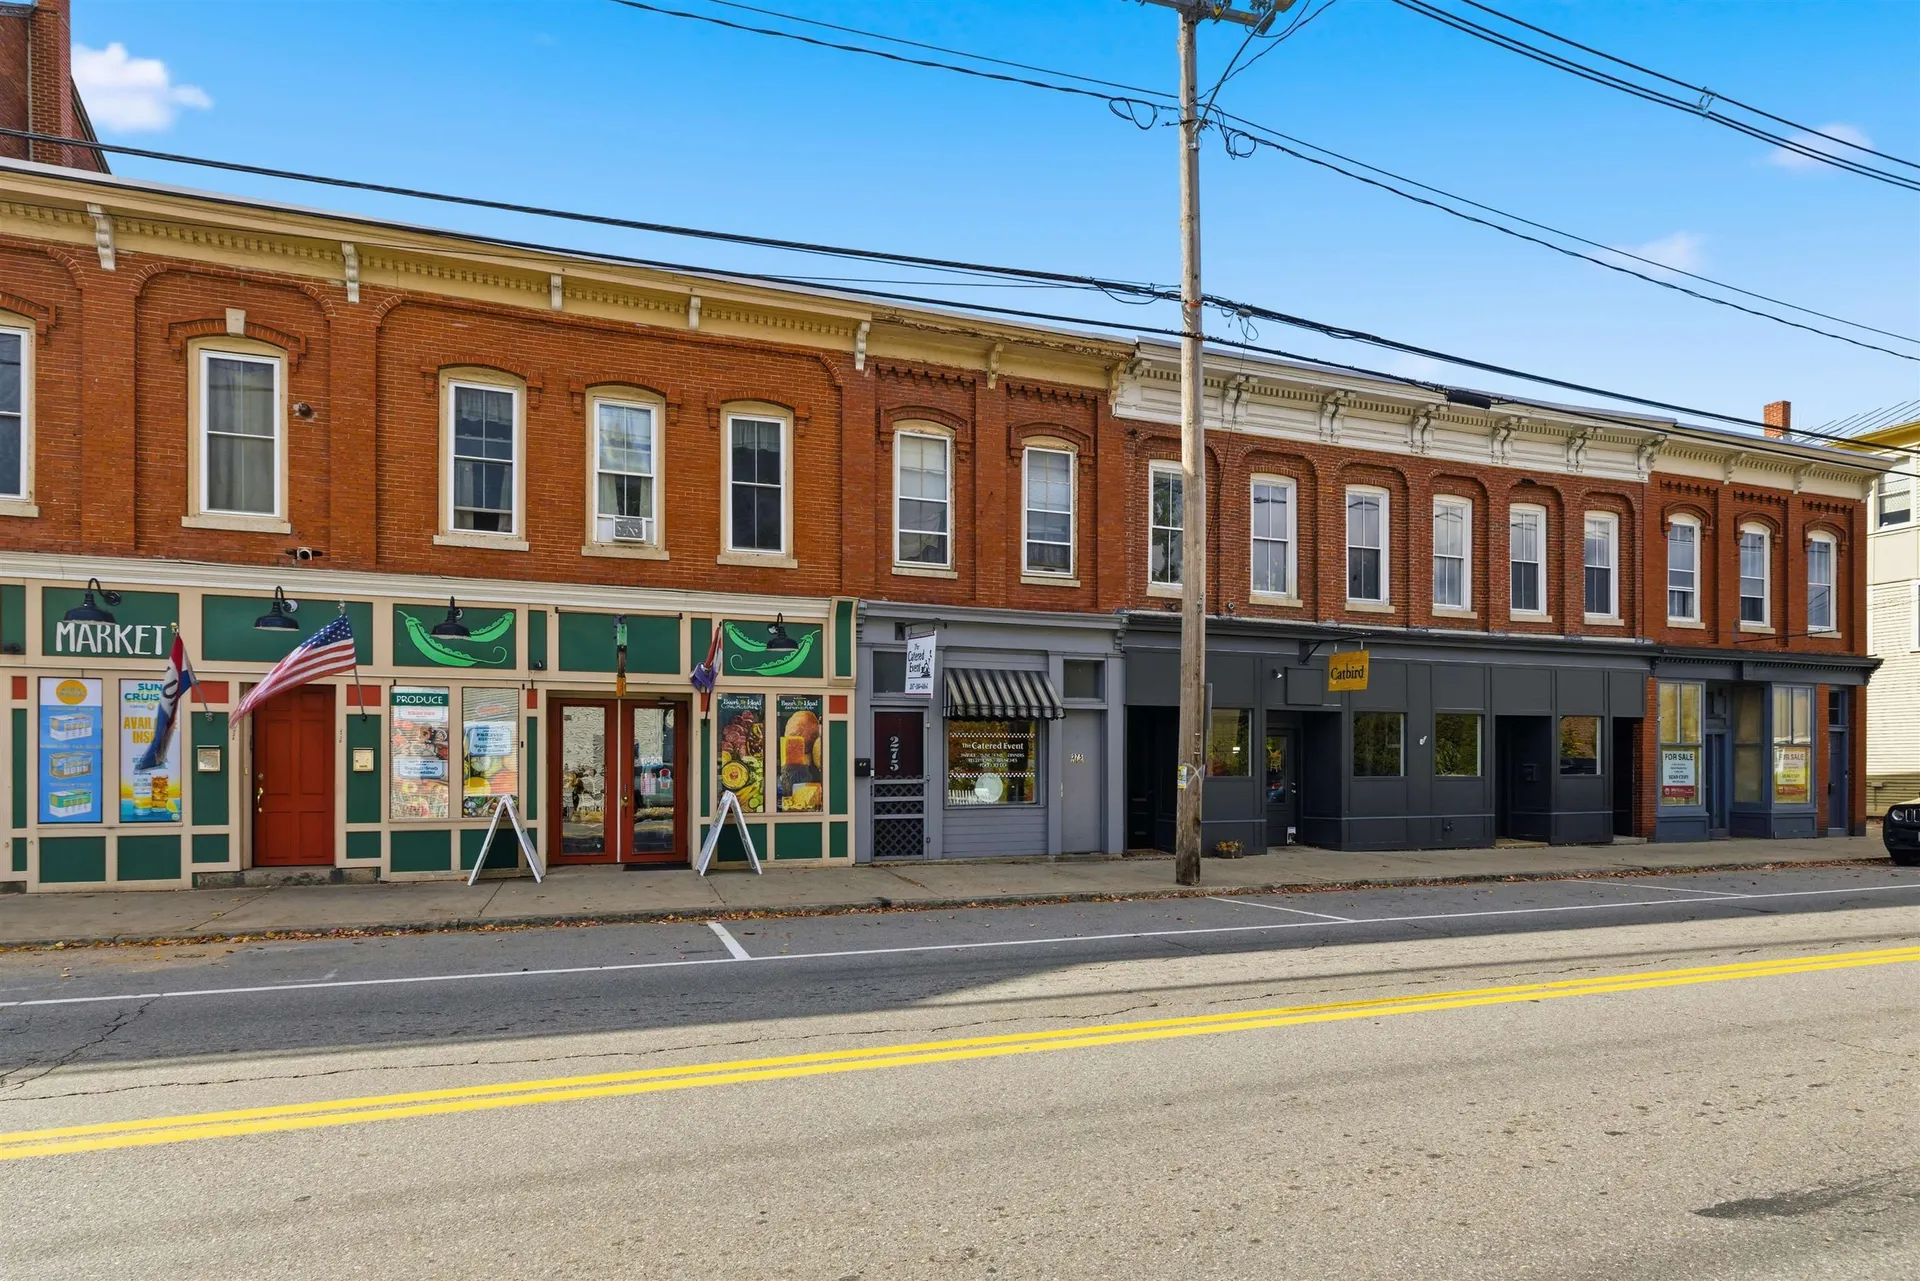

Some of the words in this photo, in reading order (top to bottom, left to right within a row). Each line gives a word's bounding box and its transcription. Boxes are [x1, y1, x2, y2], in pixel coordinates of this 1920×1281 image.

[55, 621, 167, 655] MARKET
[908, 649, 925, 661] Catered
[909, 662, 921, 672] Event
[1331, 663, 1364, 681] Catbird
[137, 683, 163, 691] SUN
[124, 693, 160, 701] CRUIS
[396, 695, 443, 704] PRODUCE
[971, 741, 1002, 750] Catered
[890, 736, 899, 771] 275
[1665, 753, 1677, 761] FOR
[1678, 753, 1693, 761] SALE
